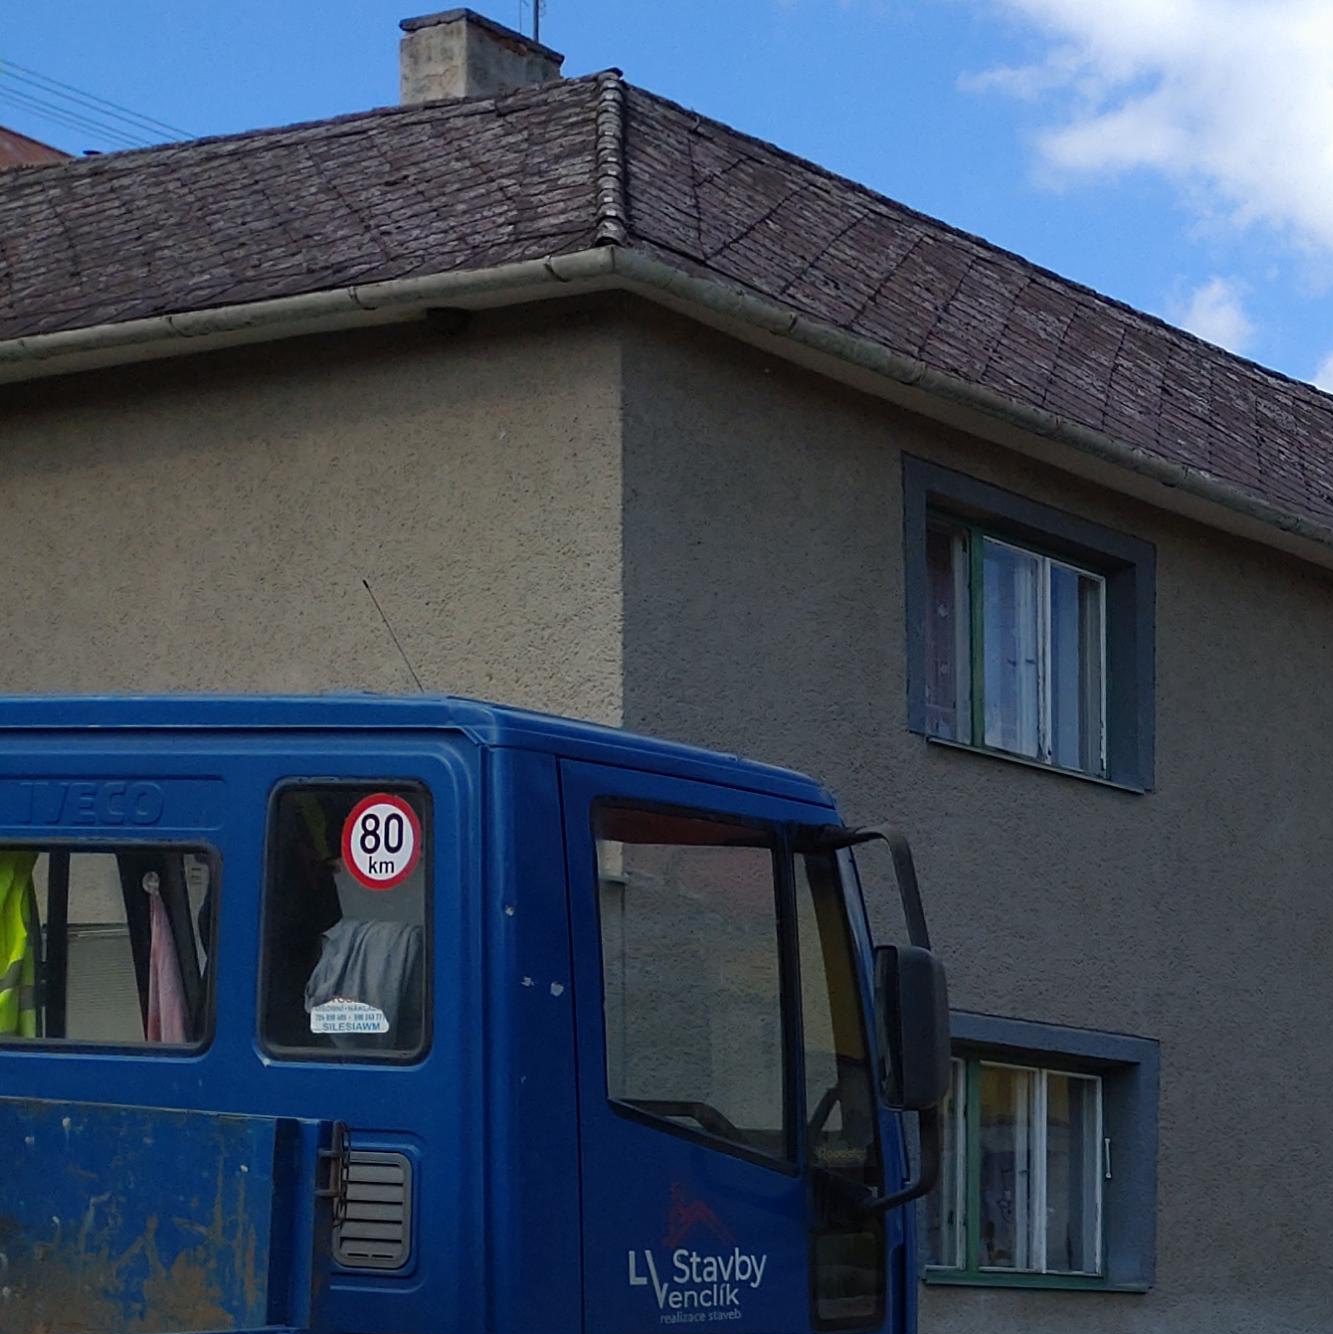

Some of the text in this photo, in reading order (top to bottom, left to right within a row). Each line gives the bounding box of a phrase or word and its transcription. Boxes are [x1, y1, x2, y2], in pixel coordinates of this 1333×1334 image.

[16, 781, 165, 826] IVECO
[360, 812, 404, 855] 80
[368, 856, 395, 874] km
[672, 1246, 767, 1288] Stavby
[660, 1308, 742, 1325] realizace staveb
